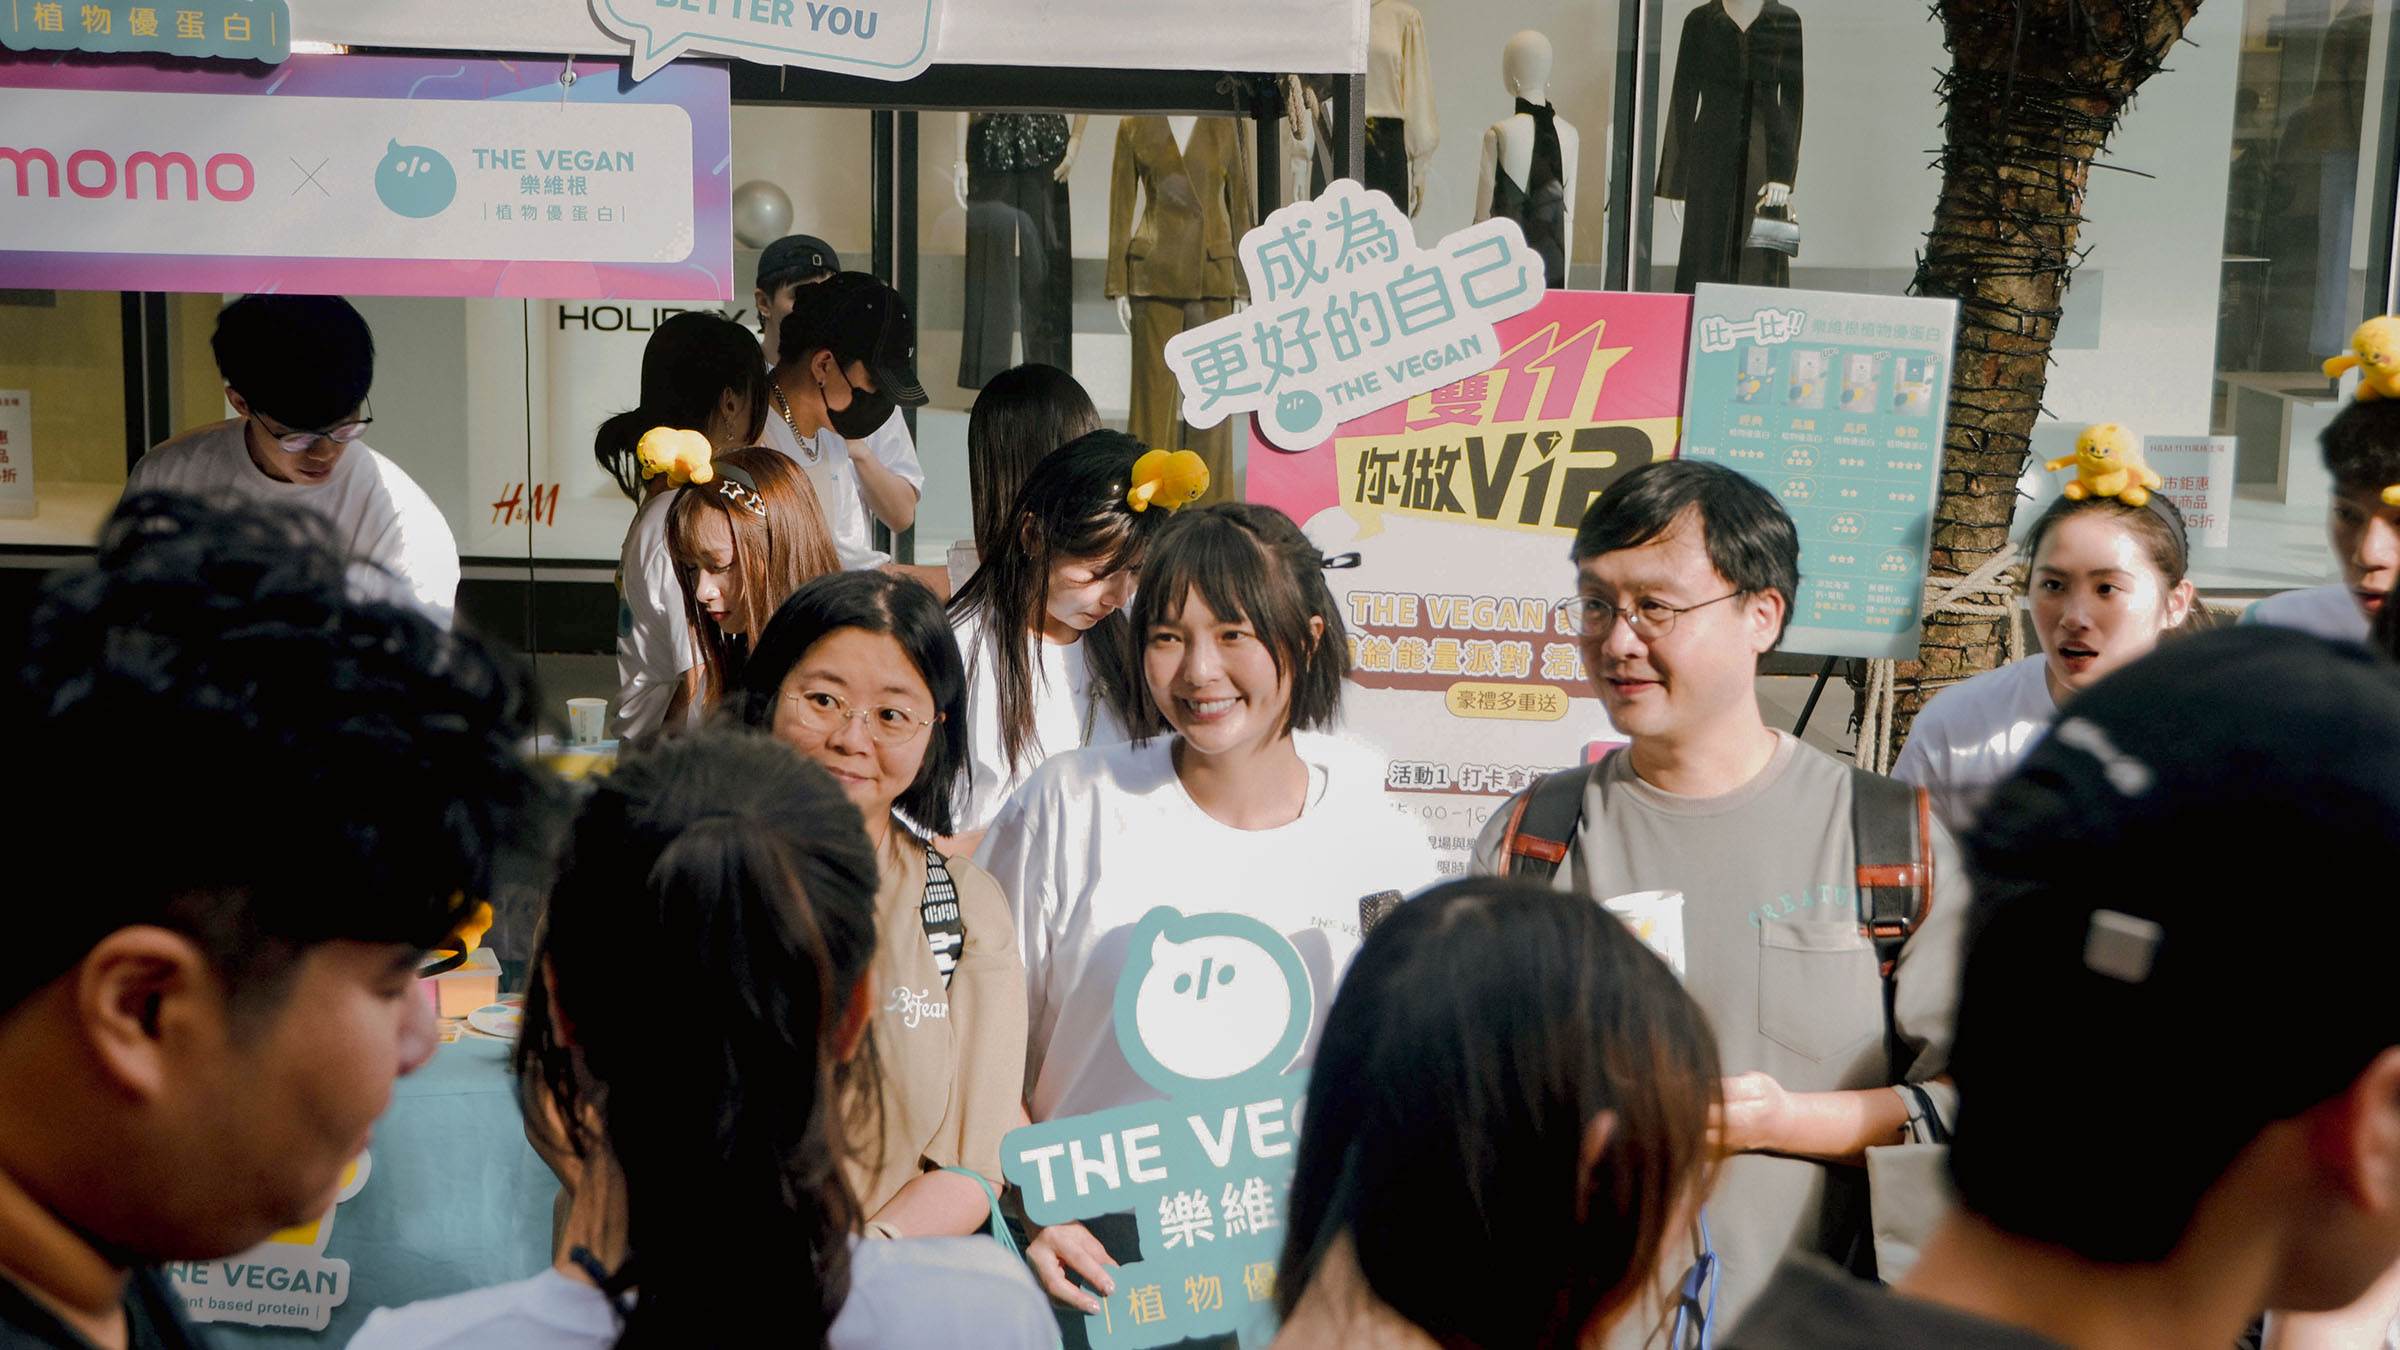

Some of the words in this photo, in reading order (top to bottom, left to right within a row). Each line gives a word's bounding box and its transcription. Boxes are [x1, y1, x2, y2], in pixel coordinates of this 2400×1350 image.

[33, 2, 251, 41] 植物優蛋白
[807, 2, 879, 40] YOU
[0, 147, 255, 202] momo
[472, 148, 527, 170] THE
[536, 149, 634, 172] VEGAN
[520, 174, 588, 196] 樂維根
[495, 204, 614, 222] 植物優蛋白
[1256, 196, 1399, 301] 成為
[1182, 235, 1527, 412] 更好的自己
[1326, 371, 1382, 406] THE
[1385, 334, 1483, 383] VEGAN
[2161, 475, 2209, 491] 市鉅惠
[492, 482, 560, 528] H&M
[1352, 594, 1416, 626] THE
[1428, 597, 1544, 630] VEGAN
[1543, 646, 1589, 679] 活
[1456, 690, 1558, 713] 豪禮多重送
[1392, 764, 1447, 785] 活動1
[1748, 883, 1858, 929] CREATU
[1019, 1123, 1168, 1204] THE
[1158, 1174, 1290, 1250] 樂維
[168, 1261, 210, 1285] HE
[223, 1262, 338, 1295] VEGAN
[208, 1296, 253, 1312] based
[257, 1303, 310, 1318] protein
